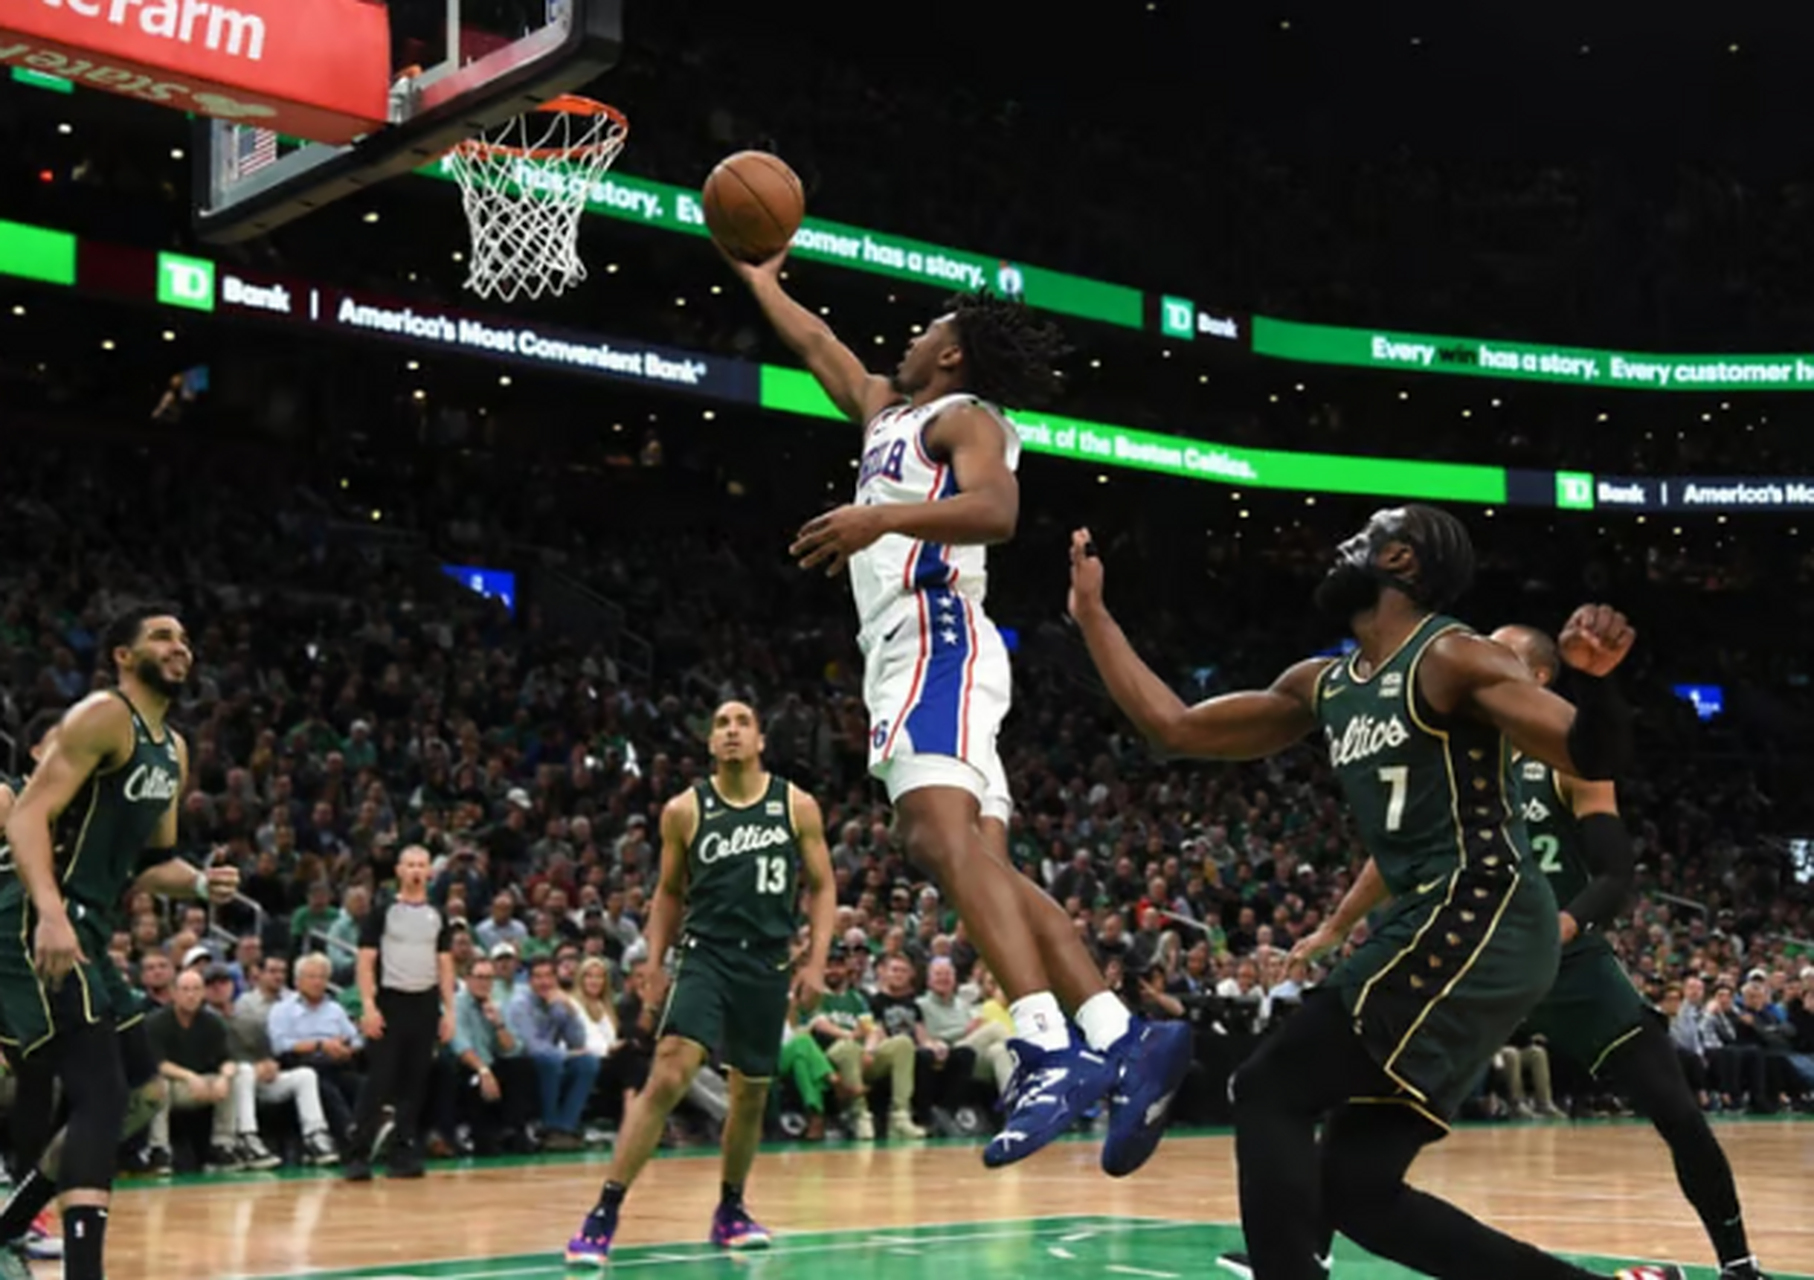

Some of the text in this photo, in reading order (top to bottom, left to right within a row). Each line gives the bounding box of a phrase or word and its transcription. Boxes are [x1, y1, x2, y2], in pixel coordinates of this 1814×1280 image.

[863, 234, 904, 268] has
[907, 251, 923, 271] a
[926, 255, 986, 288] story.
[165, 262, 291, 312] TD Bank
[338, 297, 456, 341] America's
[459, 319, 515, 351] Most
[518, 331, 642, 374] Convenient
[1166, 302, 1238, 338] TD Bank
[1372, 335, 1435, 366] Every
[1438, 344, 1477, 363] win
[1479, 345, 1519, 370] has
[1522, 355, 1537, 371] a
[1540, 353, 1600, 380] story.
[1610, 356, 1671, 386] Every
[1674, 362, 1793, 382] customer
[1055, 427, 1076, 449] of
[1079, 430, 1111, 455] the
[1563, 478, 1645, 504] TD Bank
[1683, 481, 1783, 504] America's
[1378, 764, 1409, 832] 7
[698, 824, 790, 864] Celtics
[756, 856, 787, 894] 13
